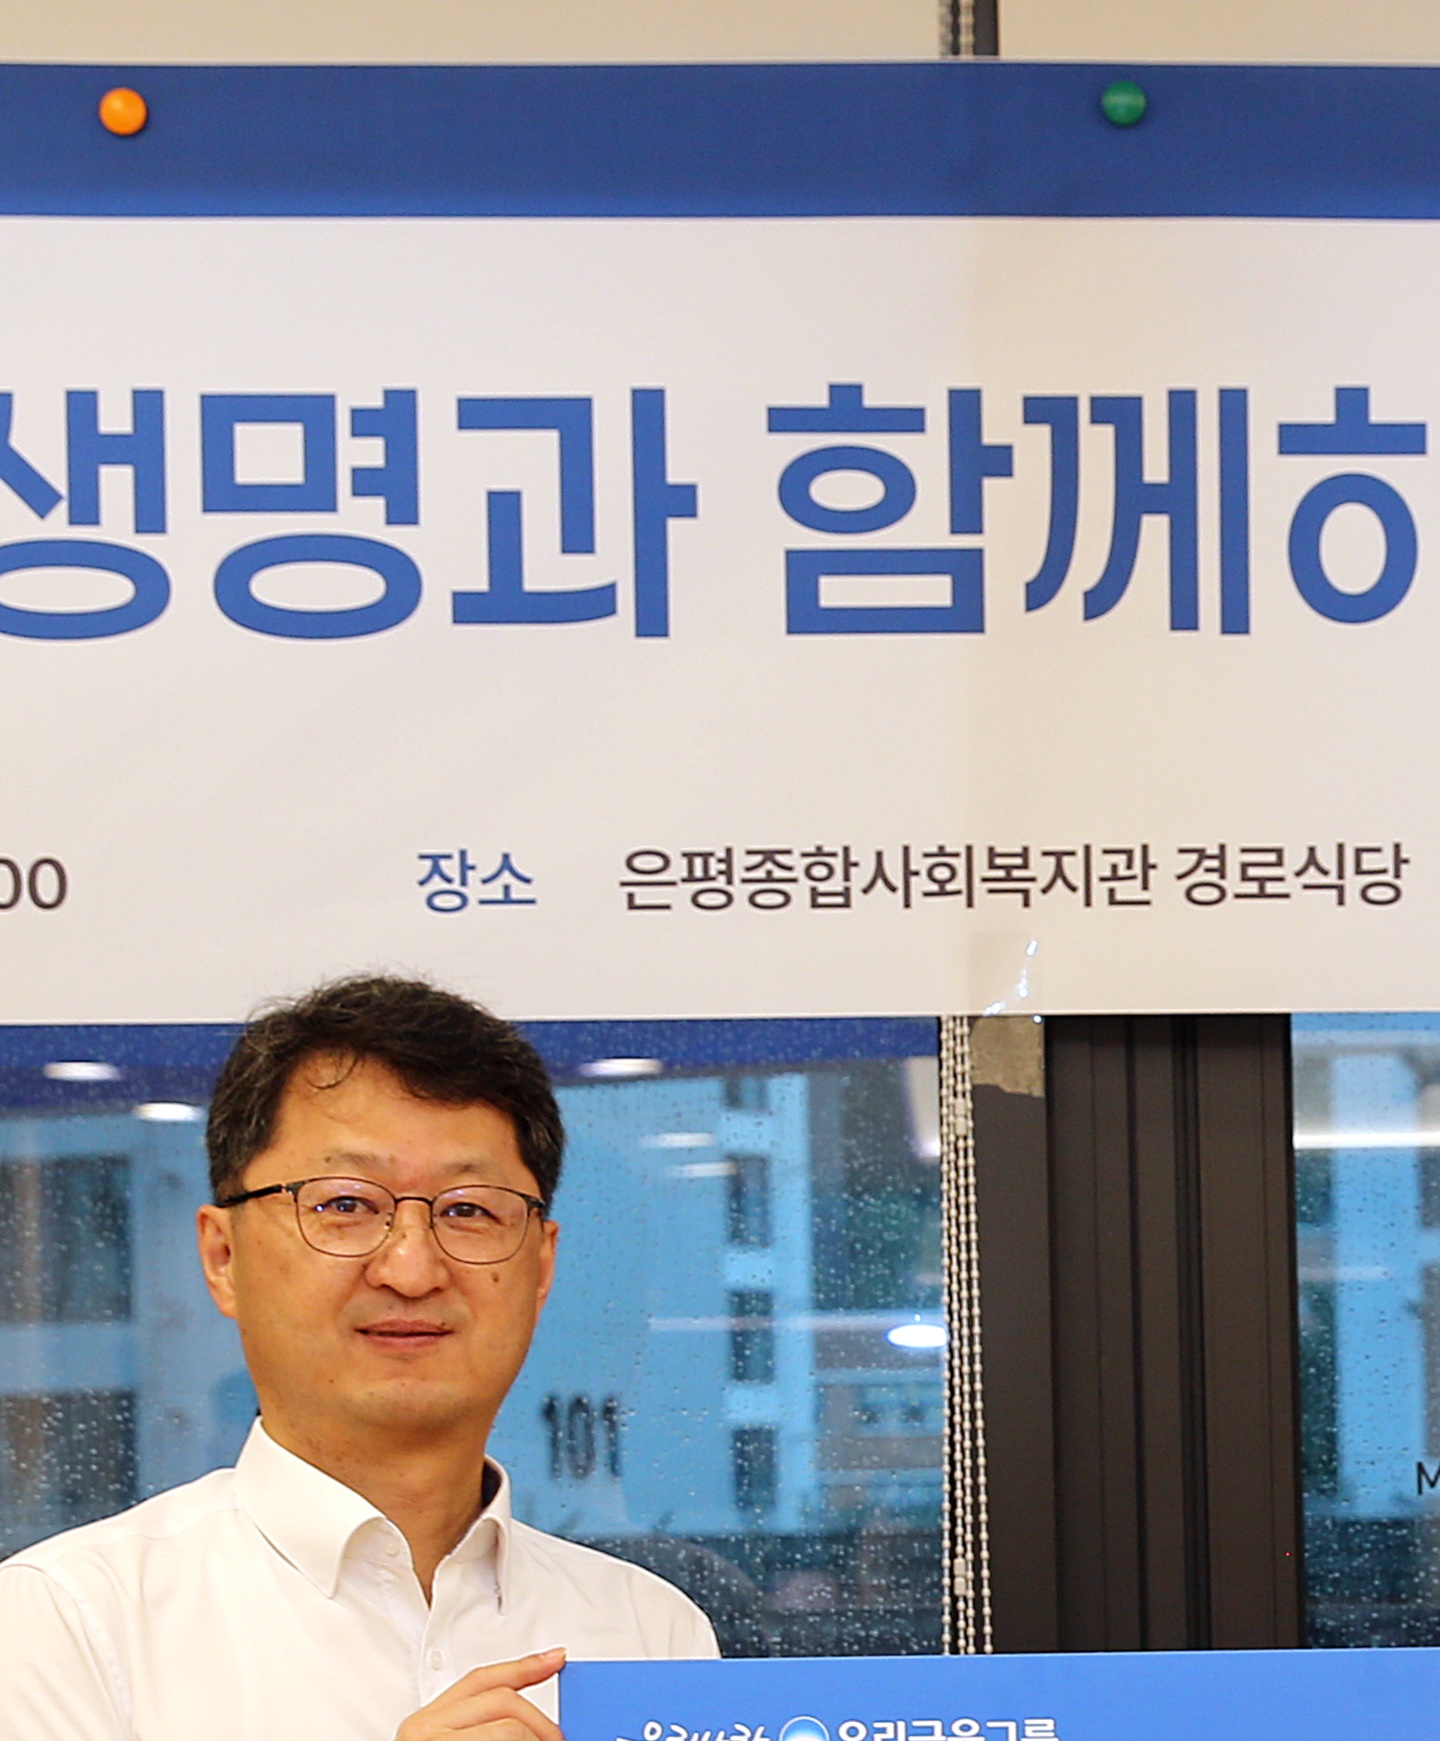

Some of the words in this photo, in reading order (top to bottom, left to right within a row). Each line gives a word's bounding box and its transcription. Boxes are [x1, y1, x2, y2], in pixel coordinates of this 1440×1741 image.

[418, 850, 536, 913] 장소
[620, 844, 1157, 910] 은평종합사회복지관
[1176, 843, 1409, 906] 경로식당
